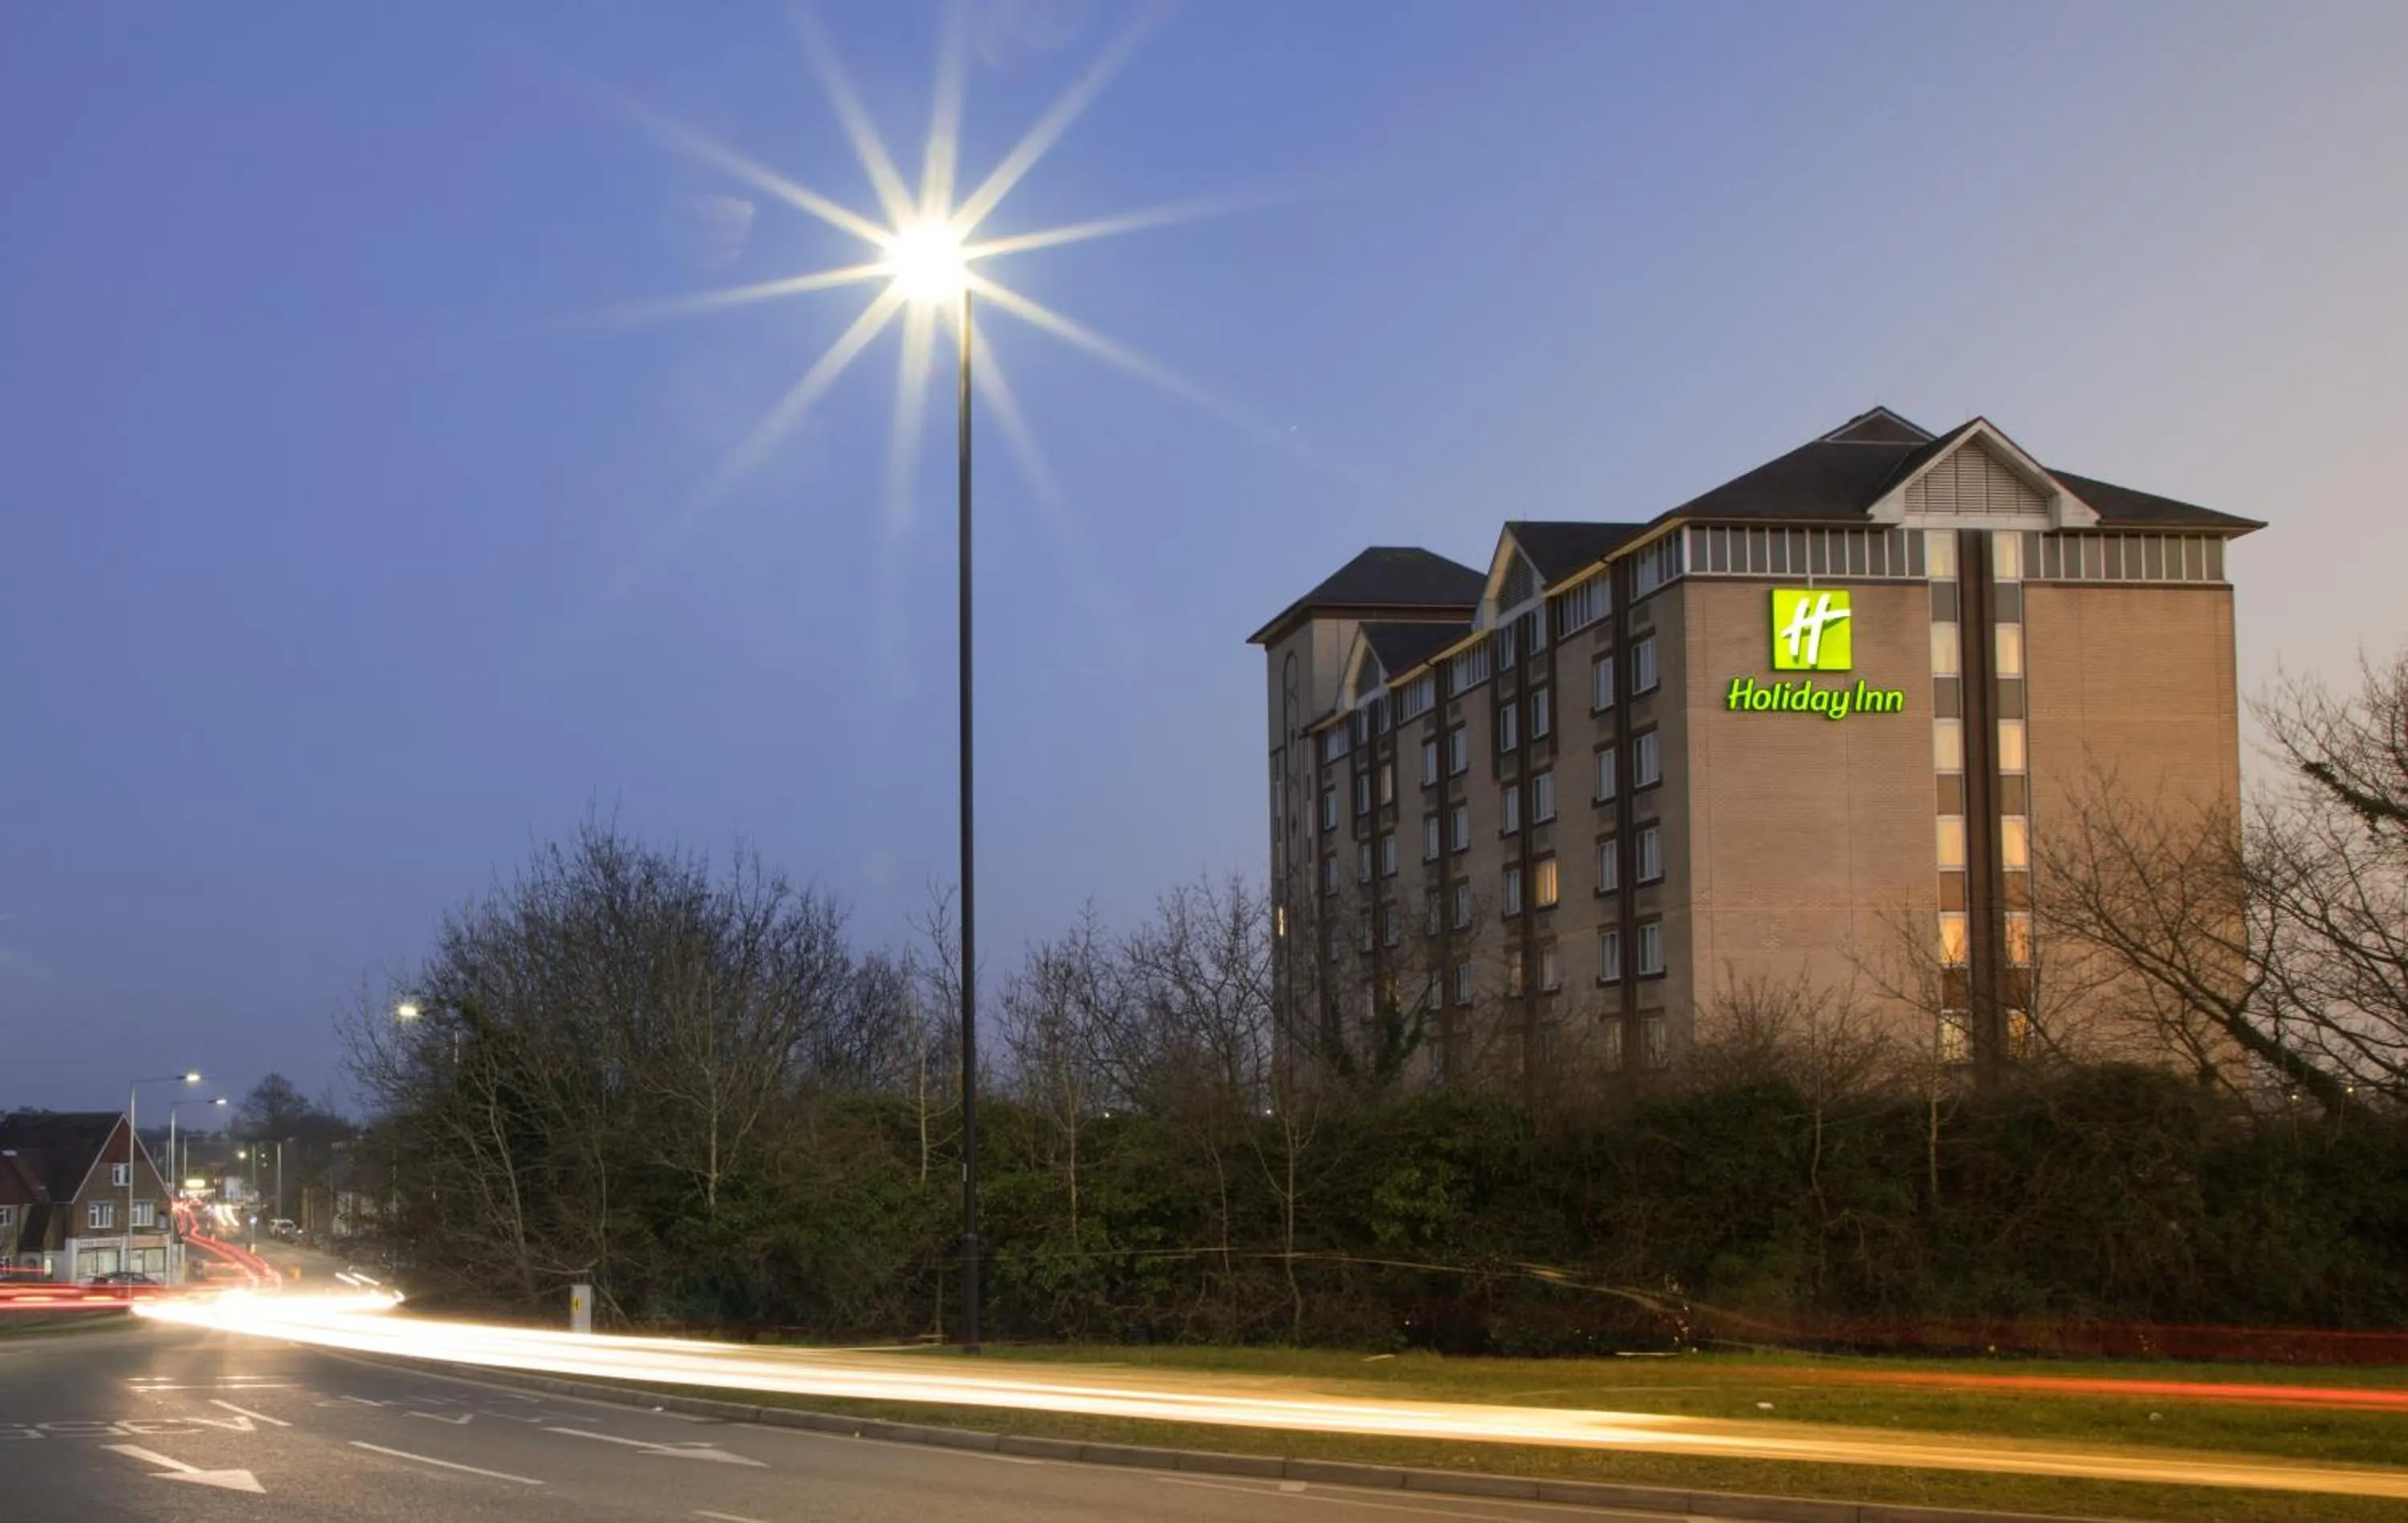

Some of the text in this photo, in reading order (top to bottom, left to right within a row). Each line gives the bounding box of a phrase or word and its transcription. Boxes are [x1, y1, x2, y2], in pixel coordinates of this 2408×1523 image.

[1780, 593, 1851, 665] H
[1727, 678, 1904, 719] Holiday Inn
